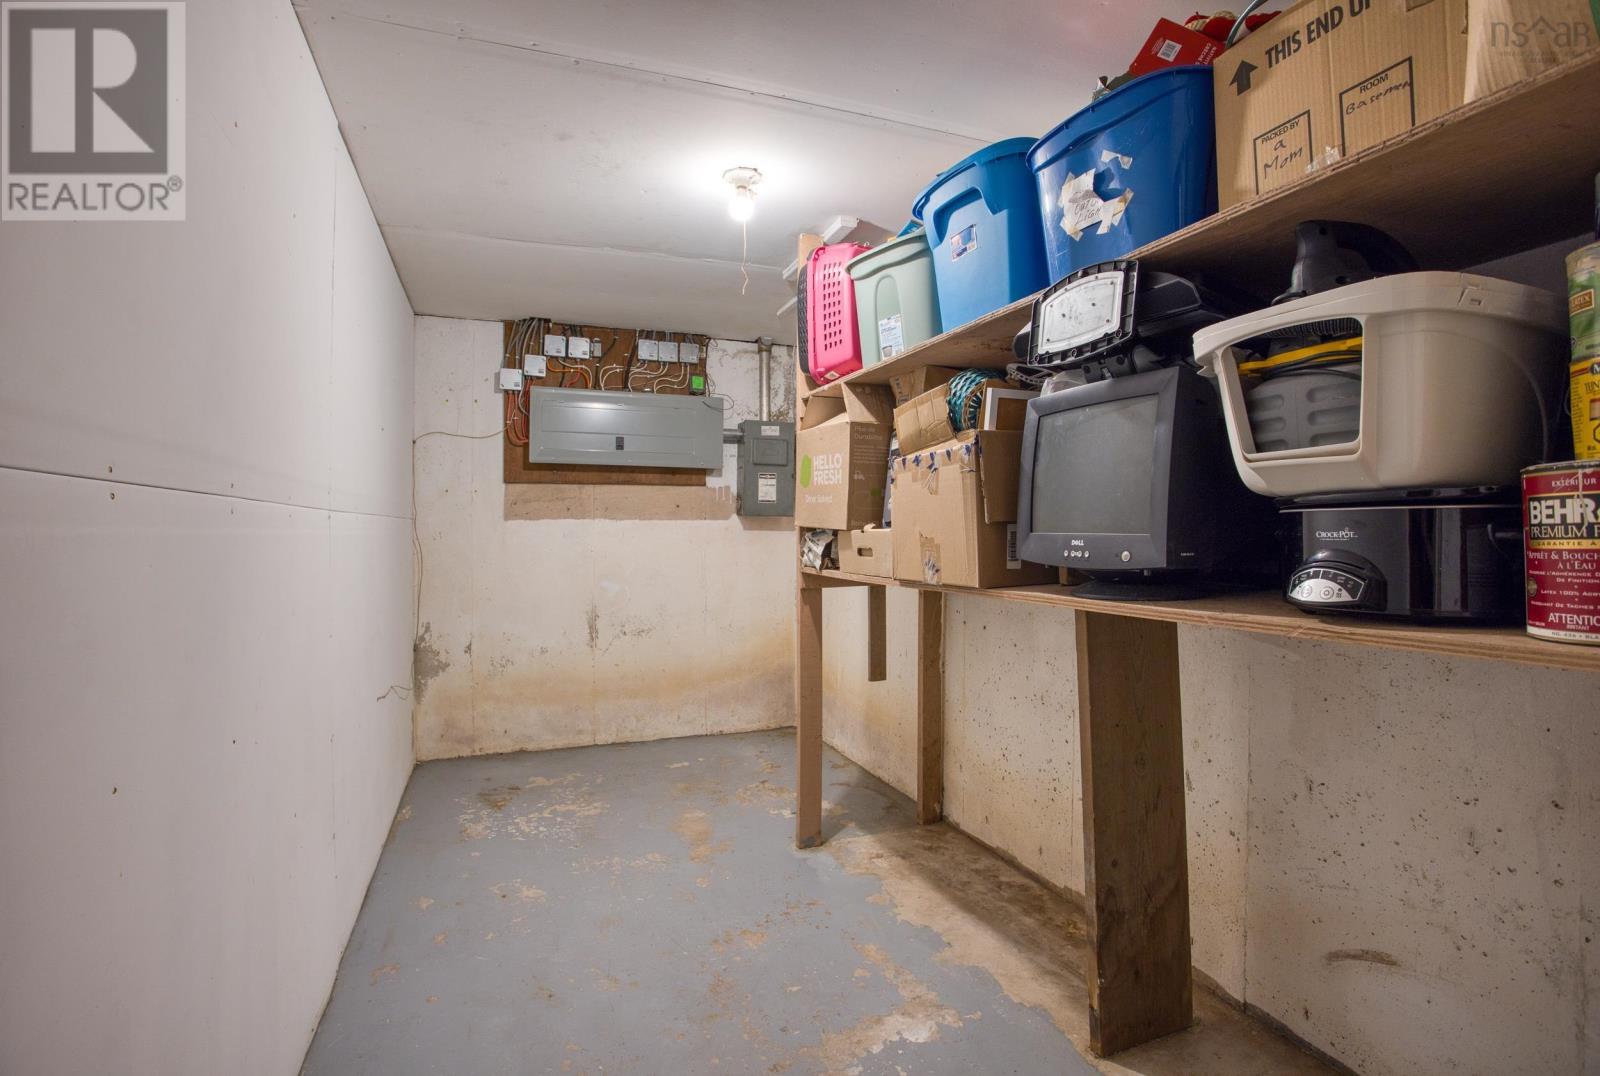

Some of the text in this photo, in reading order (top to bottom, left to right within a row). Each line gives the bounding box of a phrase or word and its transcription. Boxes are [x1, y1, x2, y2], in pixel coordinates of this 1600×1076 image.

[1264, 30, 1302, 69] THIS
[1306, 5, 1344, 45] END
[1360, 73, 1389, 94] ROOM
[1261, 120, 1300, 144] PACKED BY
[1263, 146, 1303, 180] Mom
[813, 453, 842, 469] HELLO
[813, 468, 842, 487] FRESH
[1551, 477, 1597, 488] EXTÉRIUR
[1529, 498, 1597, 525] BEHR
[1531, 525, 1587, 538] PREMIUM
[1551, 551, 1560, 560] &
